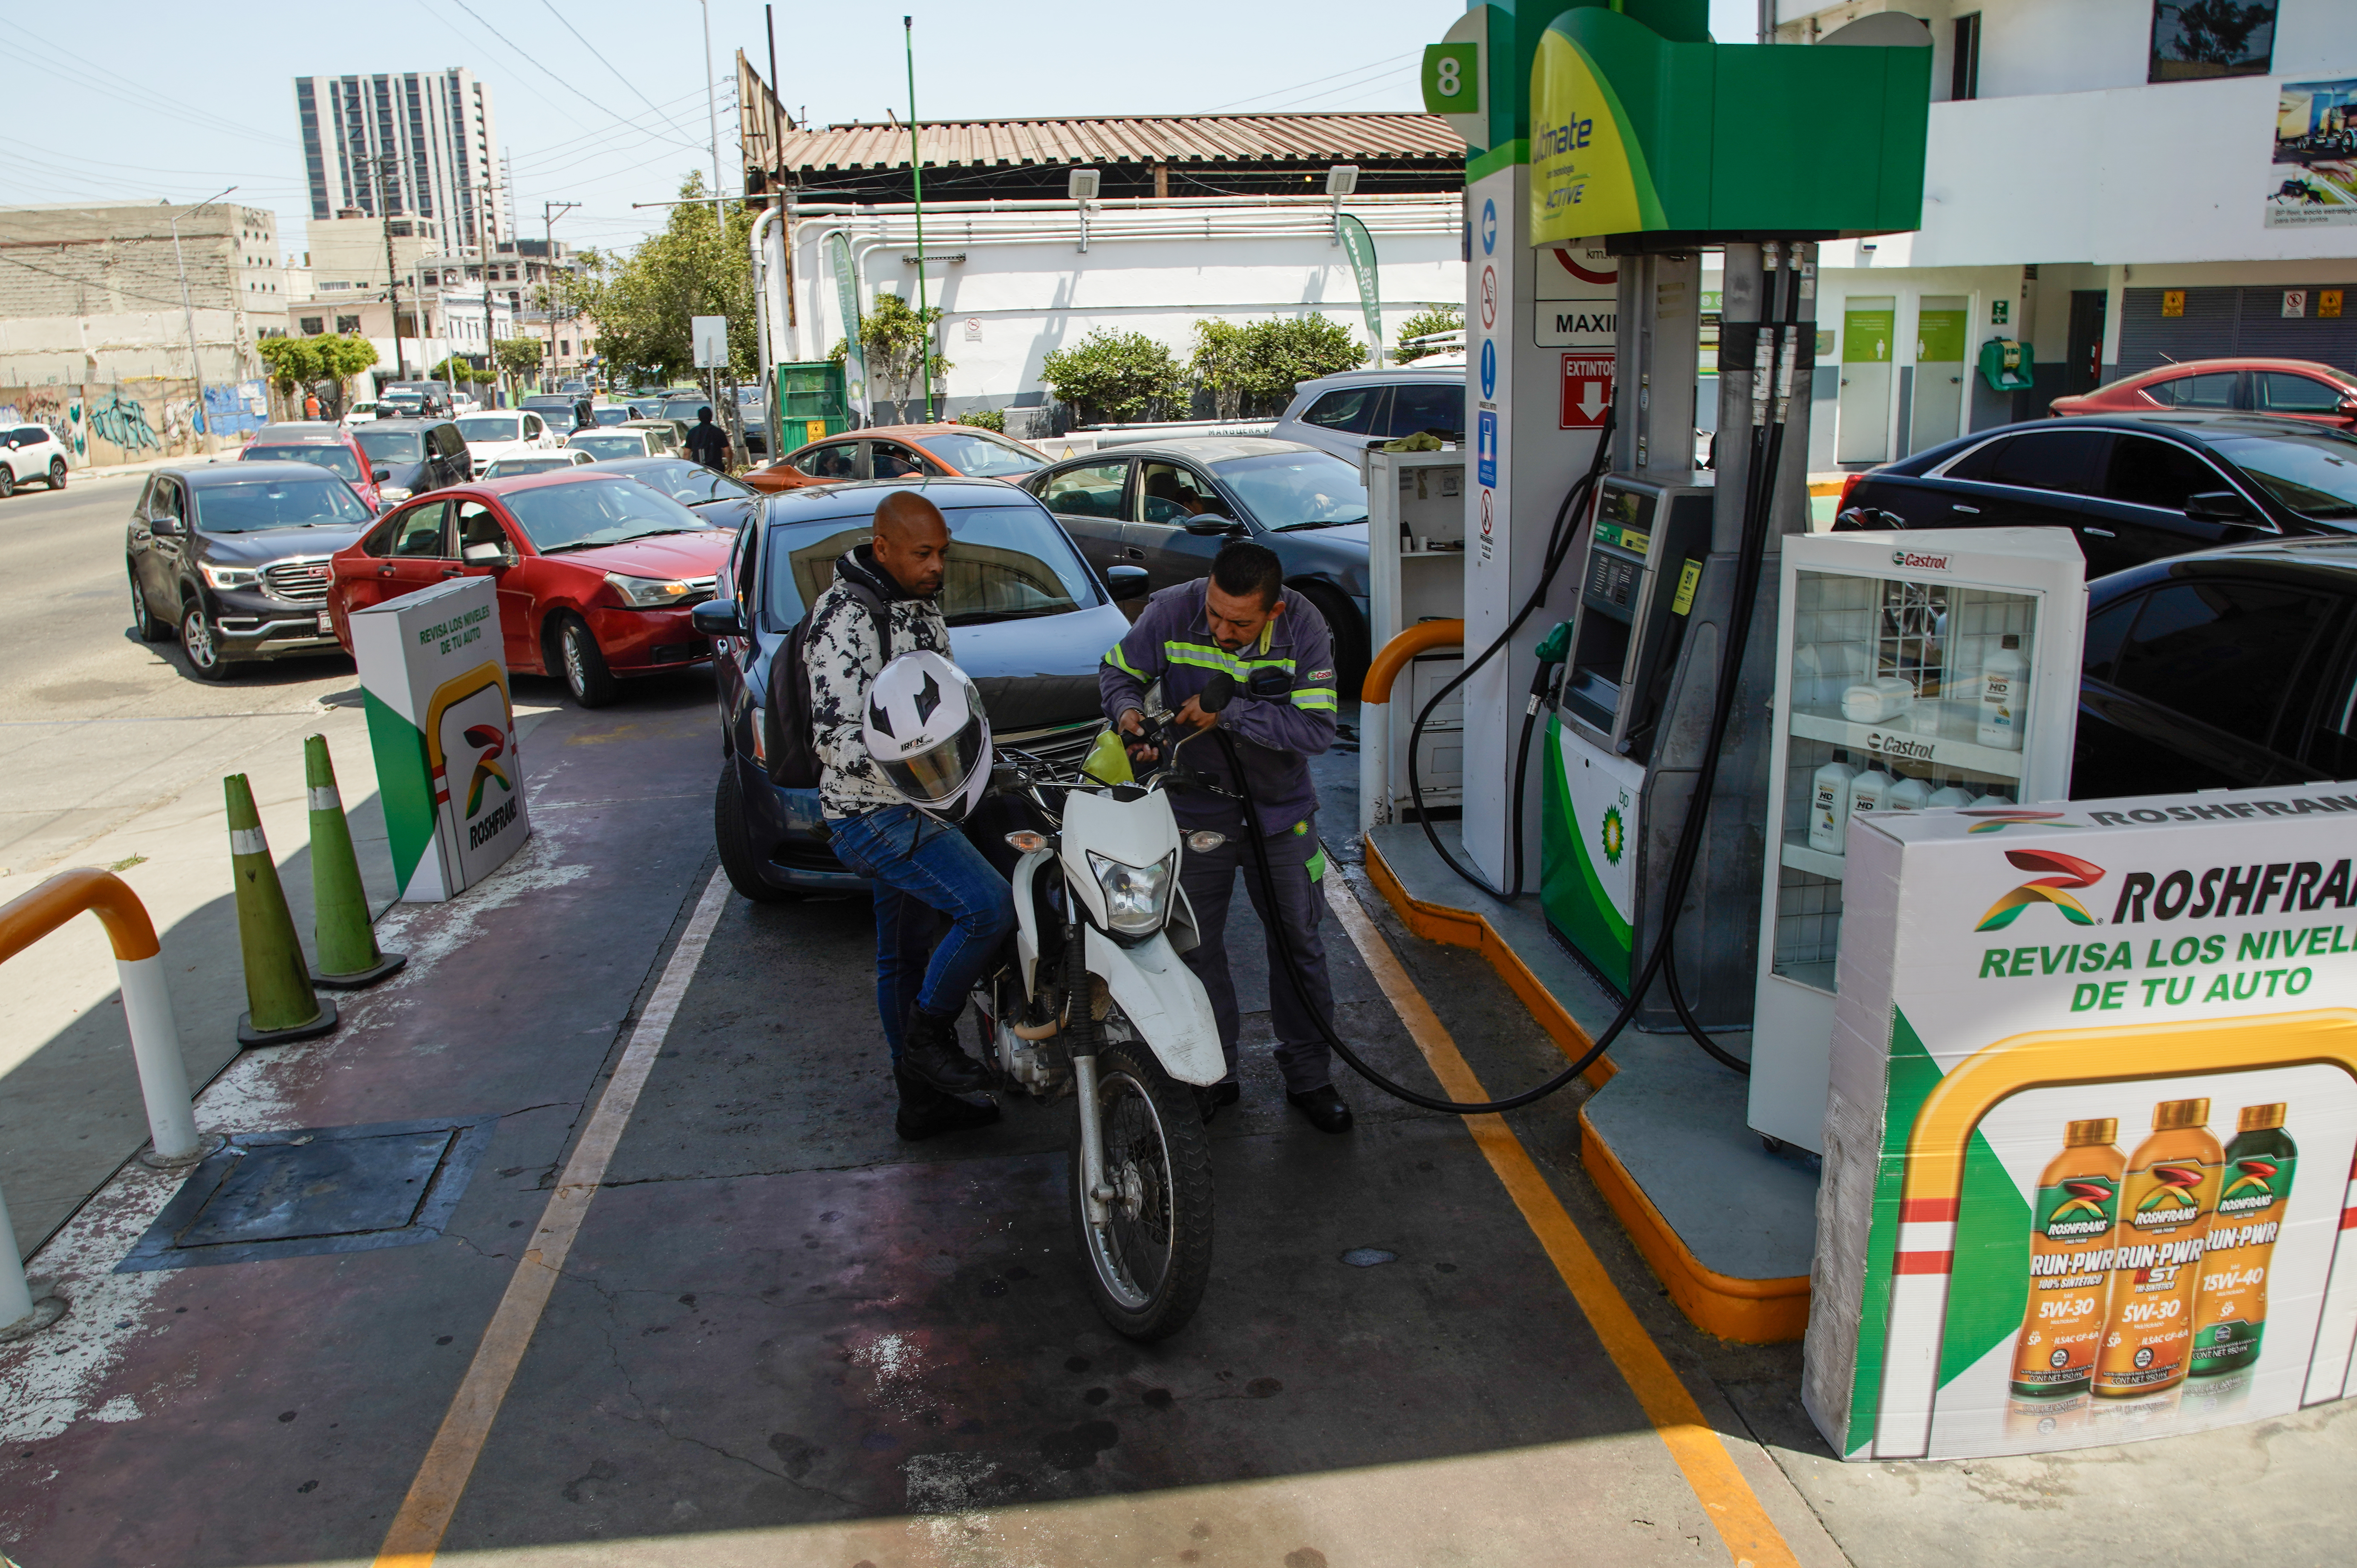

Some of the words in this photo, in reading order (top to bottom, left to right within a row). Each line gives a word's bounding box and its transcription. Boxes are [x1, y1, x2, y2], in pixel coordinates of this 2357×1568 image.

[1436, 57, 1461, 97] 8
[1546, 184, 1585, 210] ACTIVE
[2309, 216, 2329, 224] juntos
[1557, 314, 1617, 332] MAXI
[1209, 427, 1261, 435] MANGUERA
[1904, 553, 1947, 570] Castrol
[420, 622, 449, 645] REVISA
[449, 616, 463, 633] LOS
[463, 605, 490, 627] NIVELES
[441, 639, 451, 655] DE
[452, 634, 462, 650] TU
[463, 626, 481, 646] AUTO
[1989, 683, 2008, 692] HD
[1883, 735, 1935, 761] Castrol
[1619, 787, 1629, 810] bp
[1820, 792, 1833, 801] HD
[1857, 801, 1874, 810] HD
[470, 795, 517, 851] ROSHFRANS
[2111, 858, 2357, 925] ROSHFRA
[1979, 943, 2132, 978] REVISA
[2146, 934, 2227, 969] LOS
[2235, 924, 2357, 963] NIVEL
[2070, 981, 2128, 1012] DE
[2141, 976, 2195, 1007] TU
[2202, 967, 2313, 1003] AUTO
[2134, 1206, 2198, 1225] ROSHFRANS
[2047, 1219, 2108, 1236] ROSHFRANS
[2148, 1265, 2181, 1283] ST
[2203, 1267, 2265, 1291] 15W-40
[2038, 1278, 2060, 1290] 100%
[2038, 1298, 2095, 1318] 5W-30
[2121, 1299, 2181, 1323] 5W-30
[2220, 1306, 2235, 1317] SP
[2027, 1335, 2042, 1346] SP
[2054, 1334, 2076, 1345] ILSAC
[2076, 1331, 2099, 1342] GF-6A
[2107, 1336, 2122, 1348] SP
[2141, 1334, 2164, 1346] ILSAC
[2164, 1329, 2189, 1341] GF-6A
